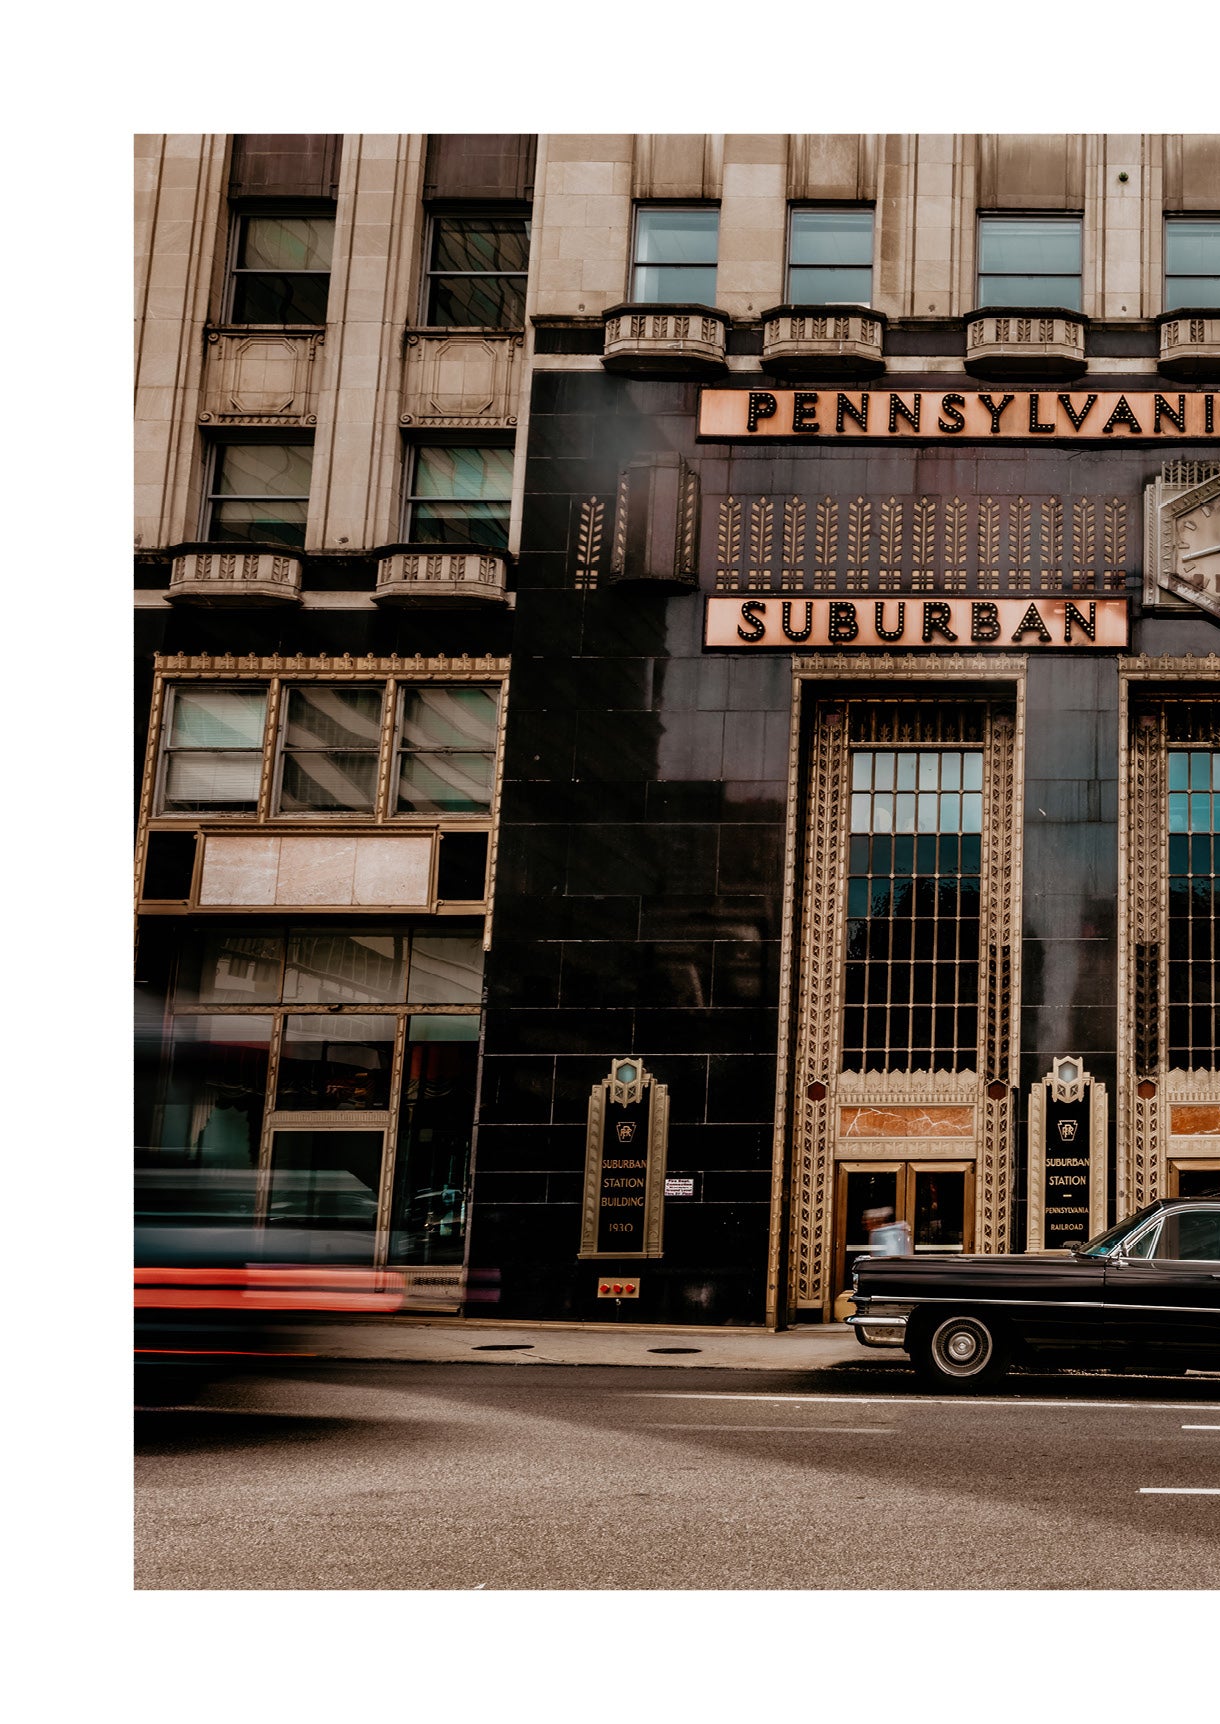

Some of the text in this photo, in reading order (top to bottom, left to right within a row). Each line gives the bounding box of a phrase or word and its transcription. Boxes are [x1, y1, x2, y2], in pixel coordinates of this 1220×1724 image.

[737, 600, 1097, 643] SUBURBAN
[602, 1159, 648, 1169] SUBURBAN
[1046, 1158, 1090, 1167] SUBURBAN
[603, 1178, 645, 1188] STATION
[1049, 1175, 1086, 1186] STATION
[601, 1197, 644, 1207] BUILDING
[1045, 1206, 1089, 1214] PENNSYLVANIA
[608, 1223, 634, 1232] 1930
[1050, 1223, 1084, 1231] RAILROAD
